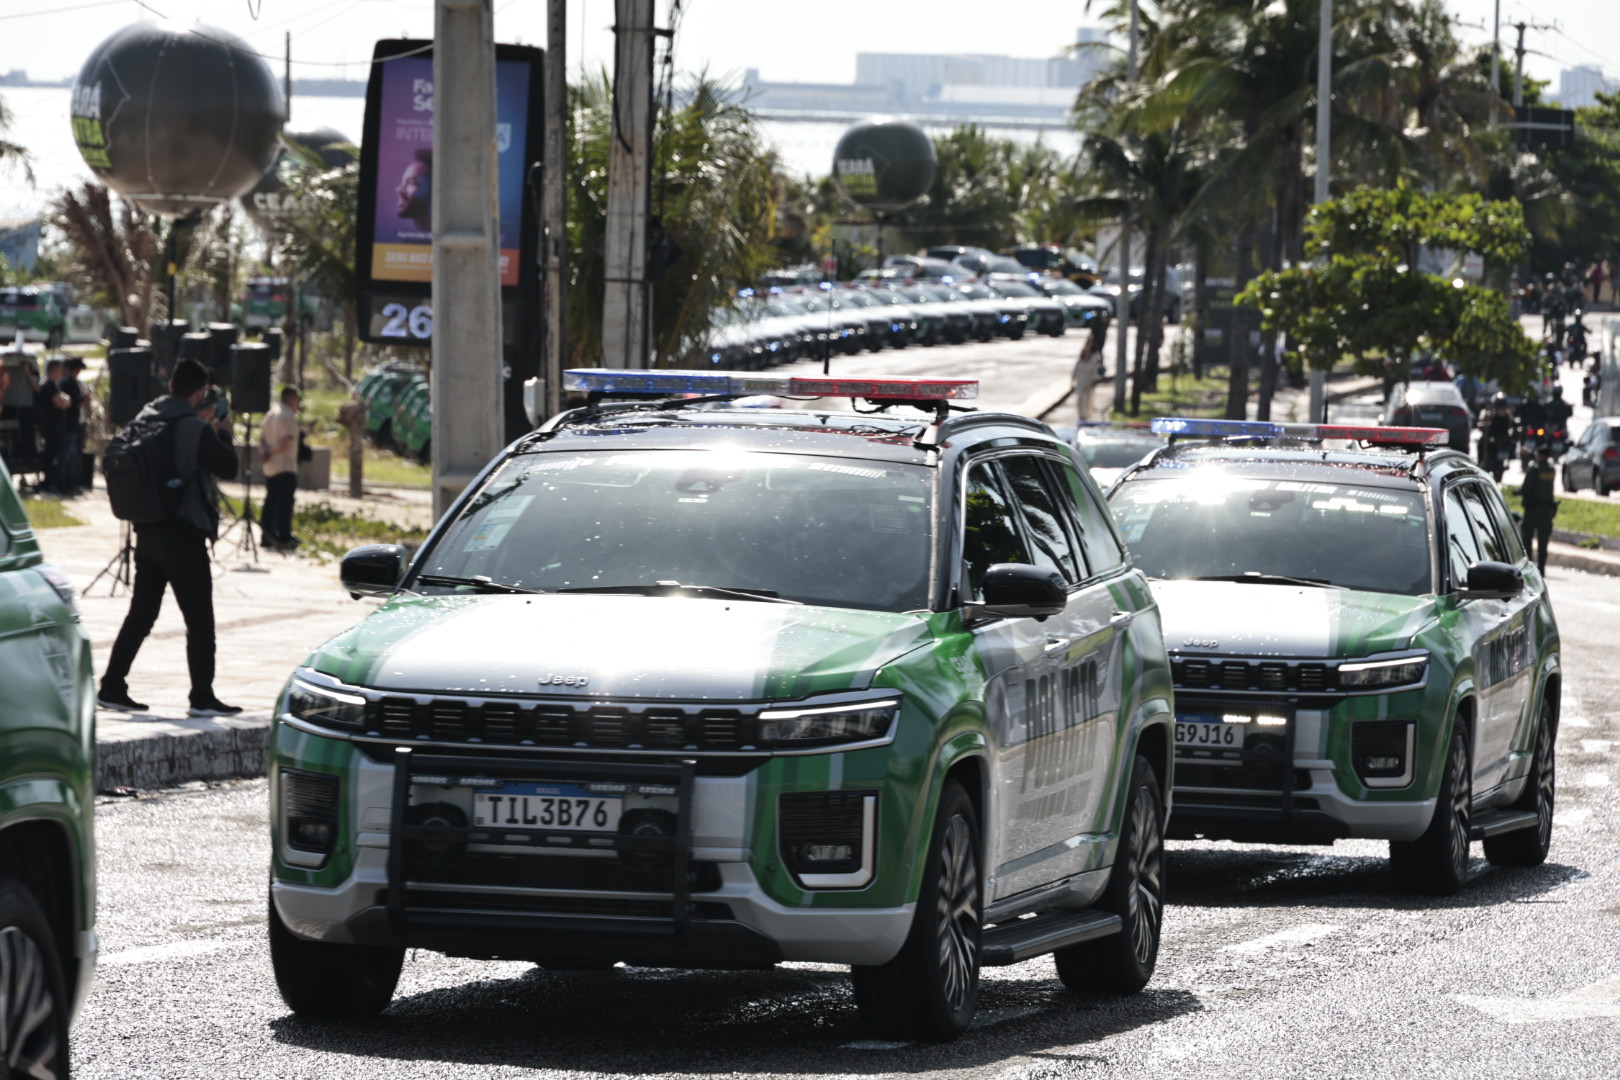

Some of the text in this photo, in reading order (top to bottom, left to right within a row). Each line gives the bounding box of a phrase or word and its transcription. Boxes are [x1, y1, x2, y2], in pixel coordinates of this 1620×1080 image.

[396, 127, 433, 141] INTE
[1183, 637, 1219, 649] Jeep
[538, 672, 588, 688] Jeep
[536, 787, 560, 795] BRASIL
[488, 796, 608, 828] TIL3B76
